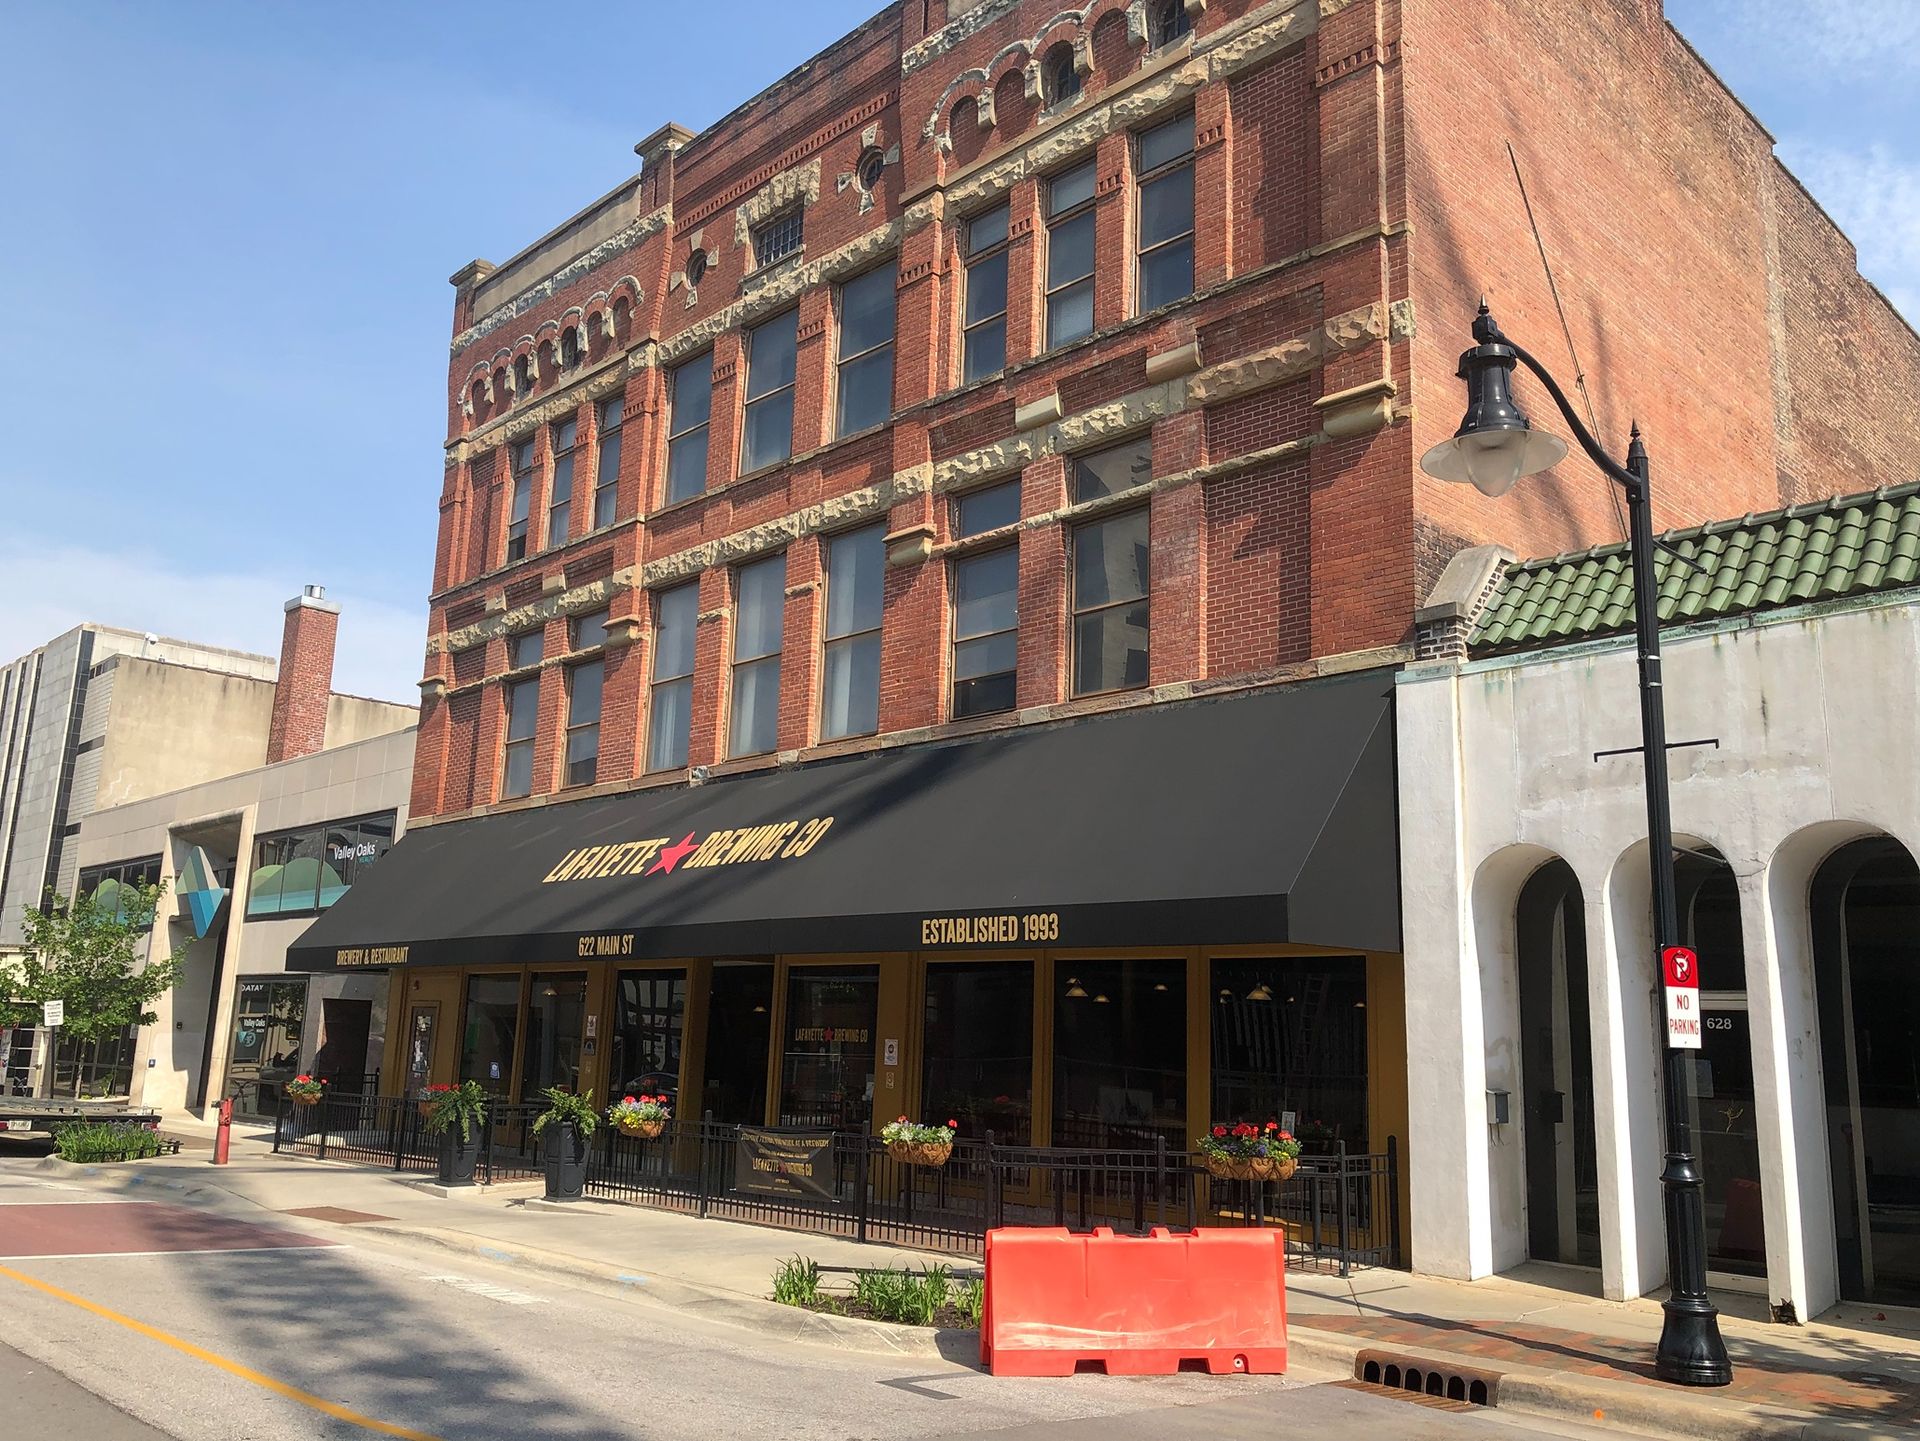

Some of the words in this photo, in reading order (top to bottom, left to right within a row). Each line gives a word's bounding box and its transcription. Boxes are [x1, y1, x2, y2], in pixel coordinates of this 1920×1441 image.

[334, 845, 356, 860] Valley
[356, 842, 376, 857] Oaks
[542, 837, 670, 883] LAFAYETTE
[682, 820, 799, 870] BREWING
[781, 816, 834, 859] CO
[922, 915, 1018, 944] ESTABLISHED
[1022, 913, 1059, 941] 1993
[578, 936, 595, 957] 622
[596, 935, 620, 956] MAIN
[621, 934, 635, 955] ST
[336, 949, 364, 966] BREWERY
[363, 948, 370, 965] &
[370, 946, 409, 964] RESTAURANT
[1676, 994, 1690, 1010] NO
[1669, 1018, 1699, 1036] PARKING
[1706, 1017, 1732, 1030] 628
[795, 1028, 824, 1041] LAFAYETTE
[834, 1028, 859, 1042] BREWING
[860, 1029, 869, 1043] CO
